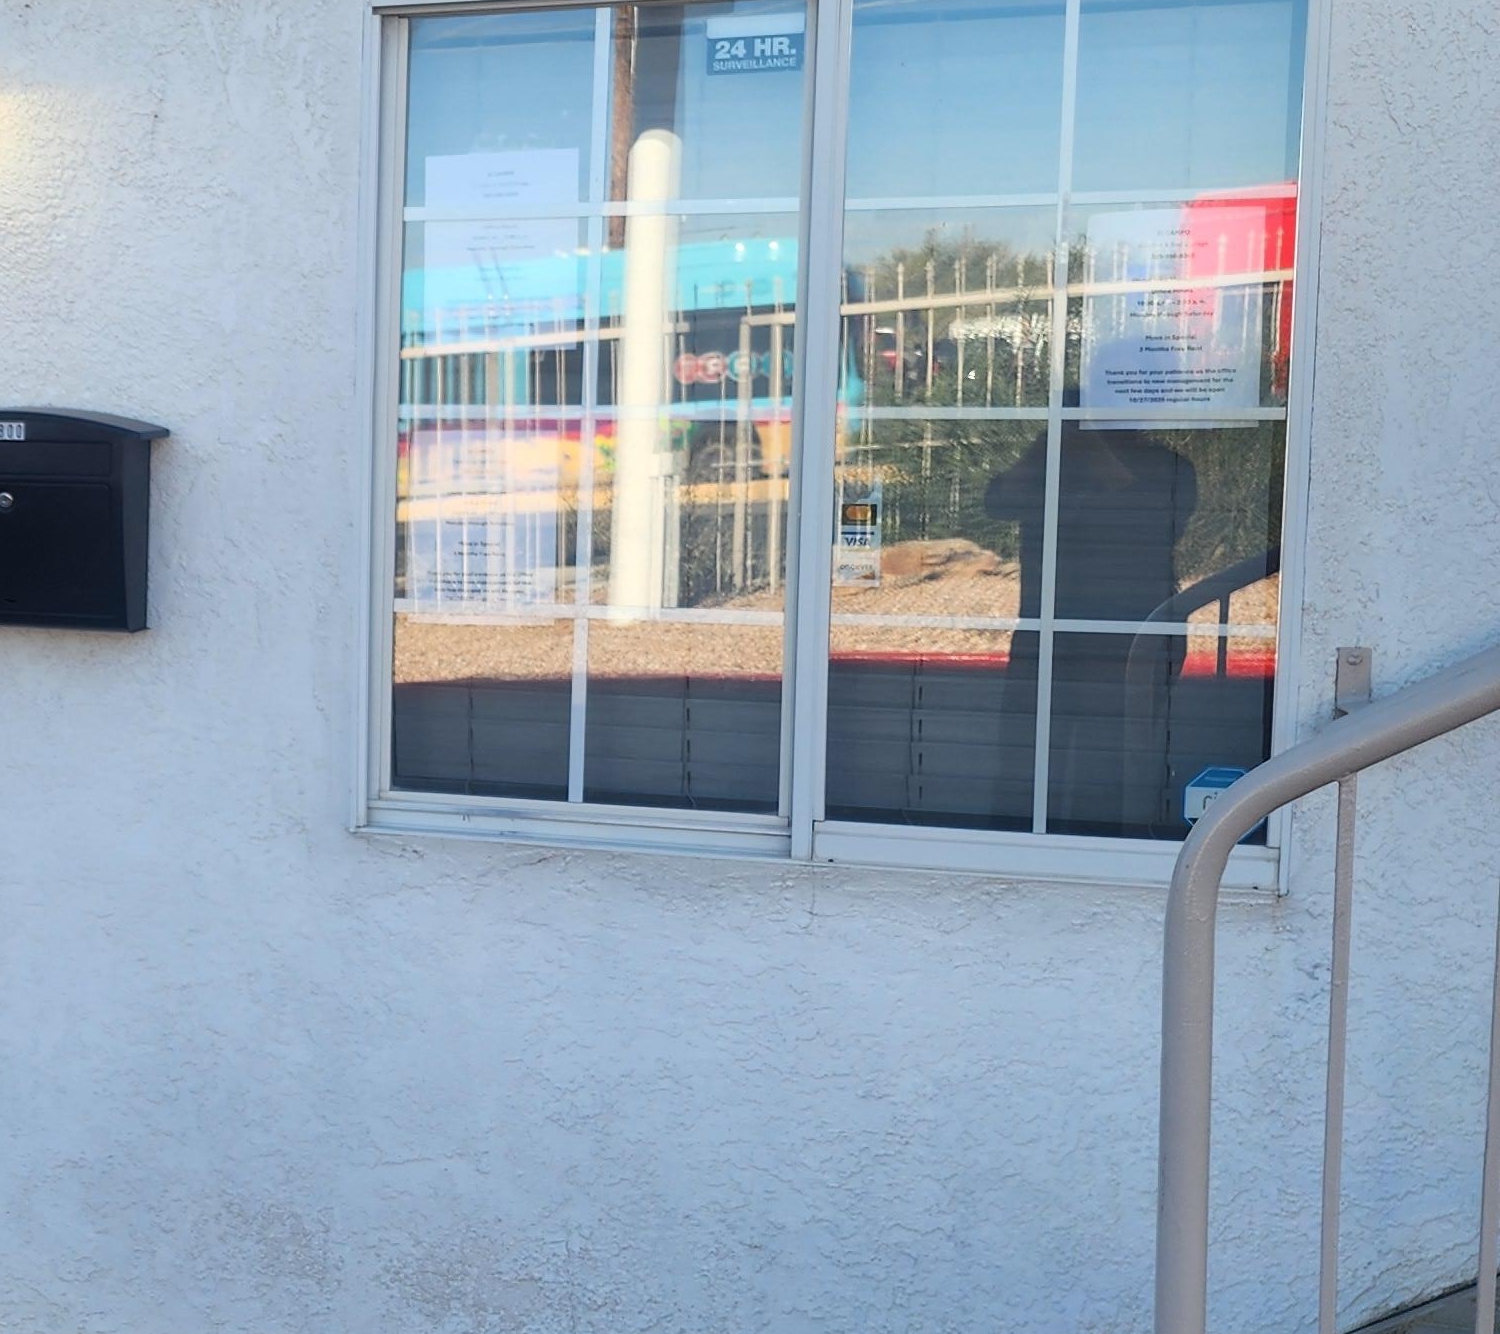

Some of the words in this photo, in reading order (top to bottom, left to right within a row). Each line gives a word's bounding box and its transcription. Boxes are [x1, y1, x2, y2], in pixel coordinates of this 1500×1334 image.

[715, 40, 746, 59] 24
[753, 37, 797, 57] HR.
[713, 57, 797, 71] SURVEILLANCE
